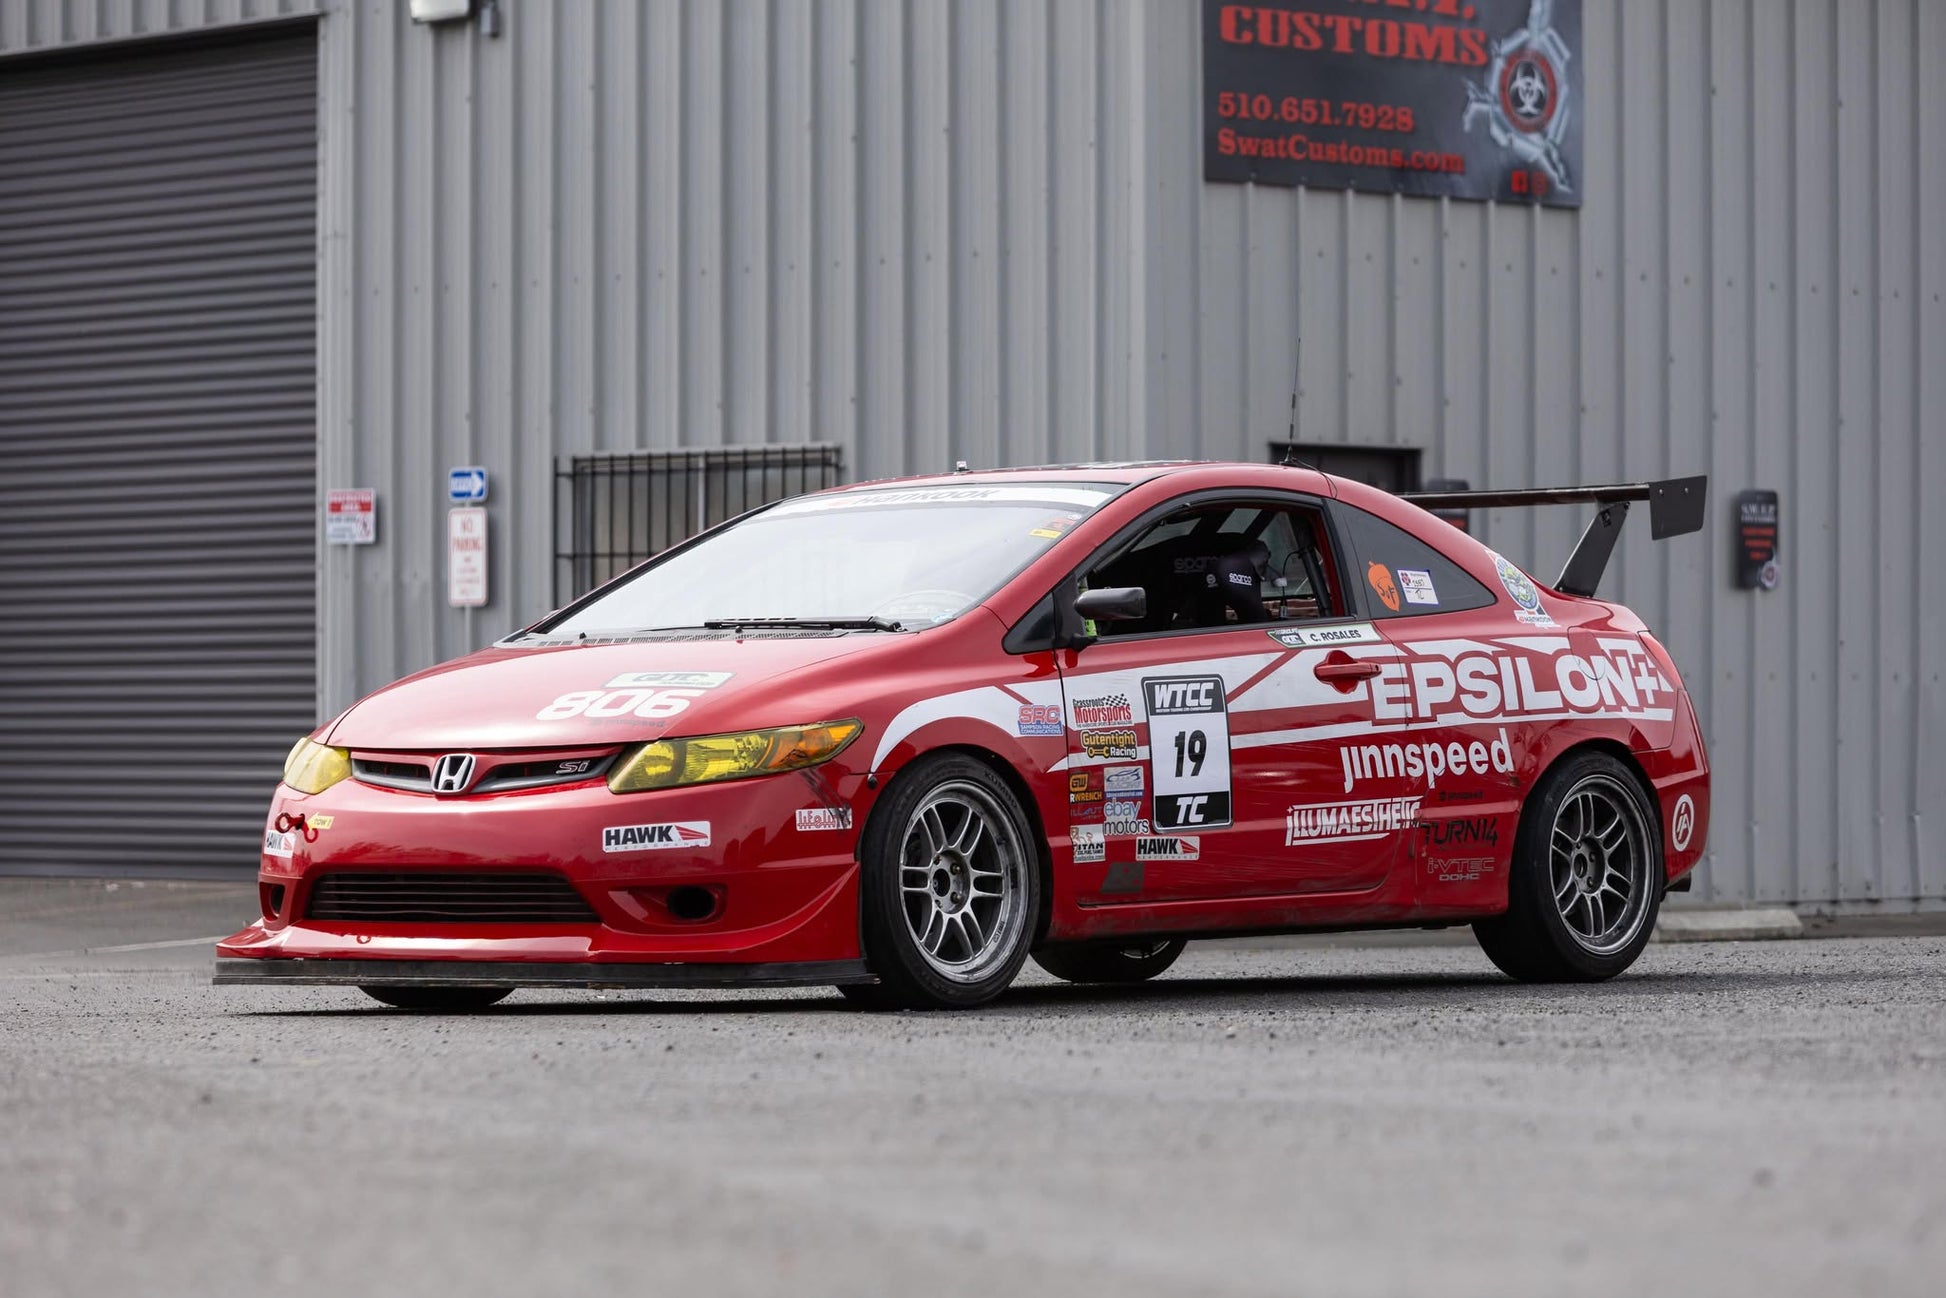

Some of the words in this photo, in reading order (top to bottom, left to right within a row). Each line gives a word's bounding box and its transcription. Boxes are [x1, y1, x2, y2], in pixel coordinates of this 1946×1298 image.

[1219, 6, 1489, 66] CUSTOMS
[1218, 92, 1415, 132] 510.651.7928
[1217, 128, 1465, 173] SwatCustoms.com
[1229, 572, 1252, 585] sparco
[1310, 633, 1320, 642] C.
[1320, 629, 1362, 641] ROSALES
[536, 689, 707, 720] 806
[1073, 698, 1105, 707] Grassroots
[1155, 682, 1214, 708] WTCC
[1019, 706, 1060, 724] SRC
[1074, 706, 1132, 725] Motorsports
[1083, 731, 1135, 747] Gutentight
[1110, 747, 1136, 758] Racing
[1175, 730, 1207, 778] 19
[1104, 798, 1141, 821] ebay
[1176, 796, 1208, 824] TC
[605, 825, 673, 846] HAWK
[1105, 818, 1149, 834] motors
[1420, 819, 1498, 847] TURN14
[1138, 838, 1179, 855] HAWK
[1439, 873, 1480, 881] DOHC
